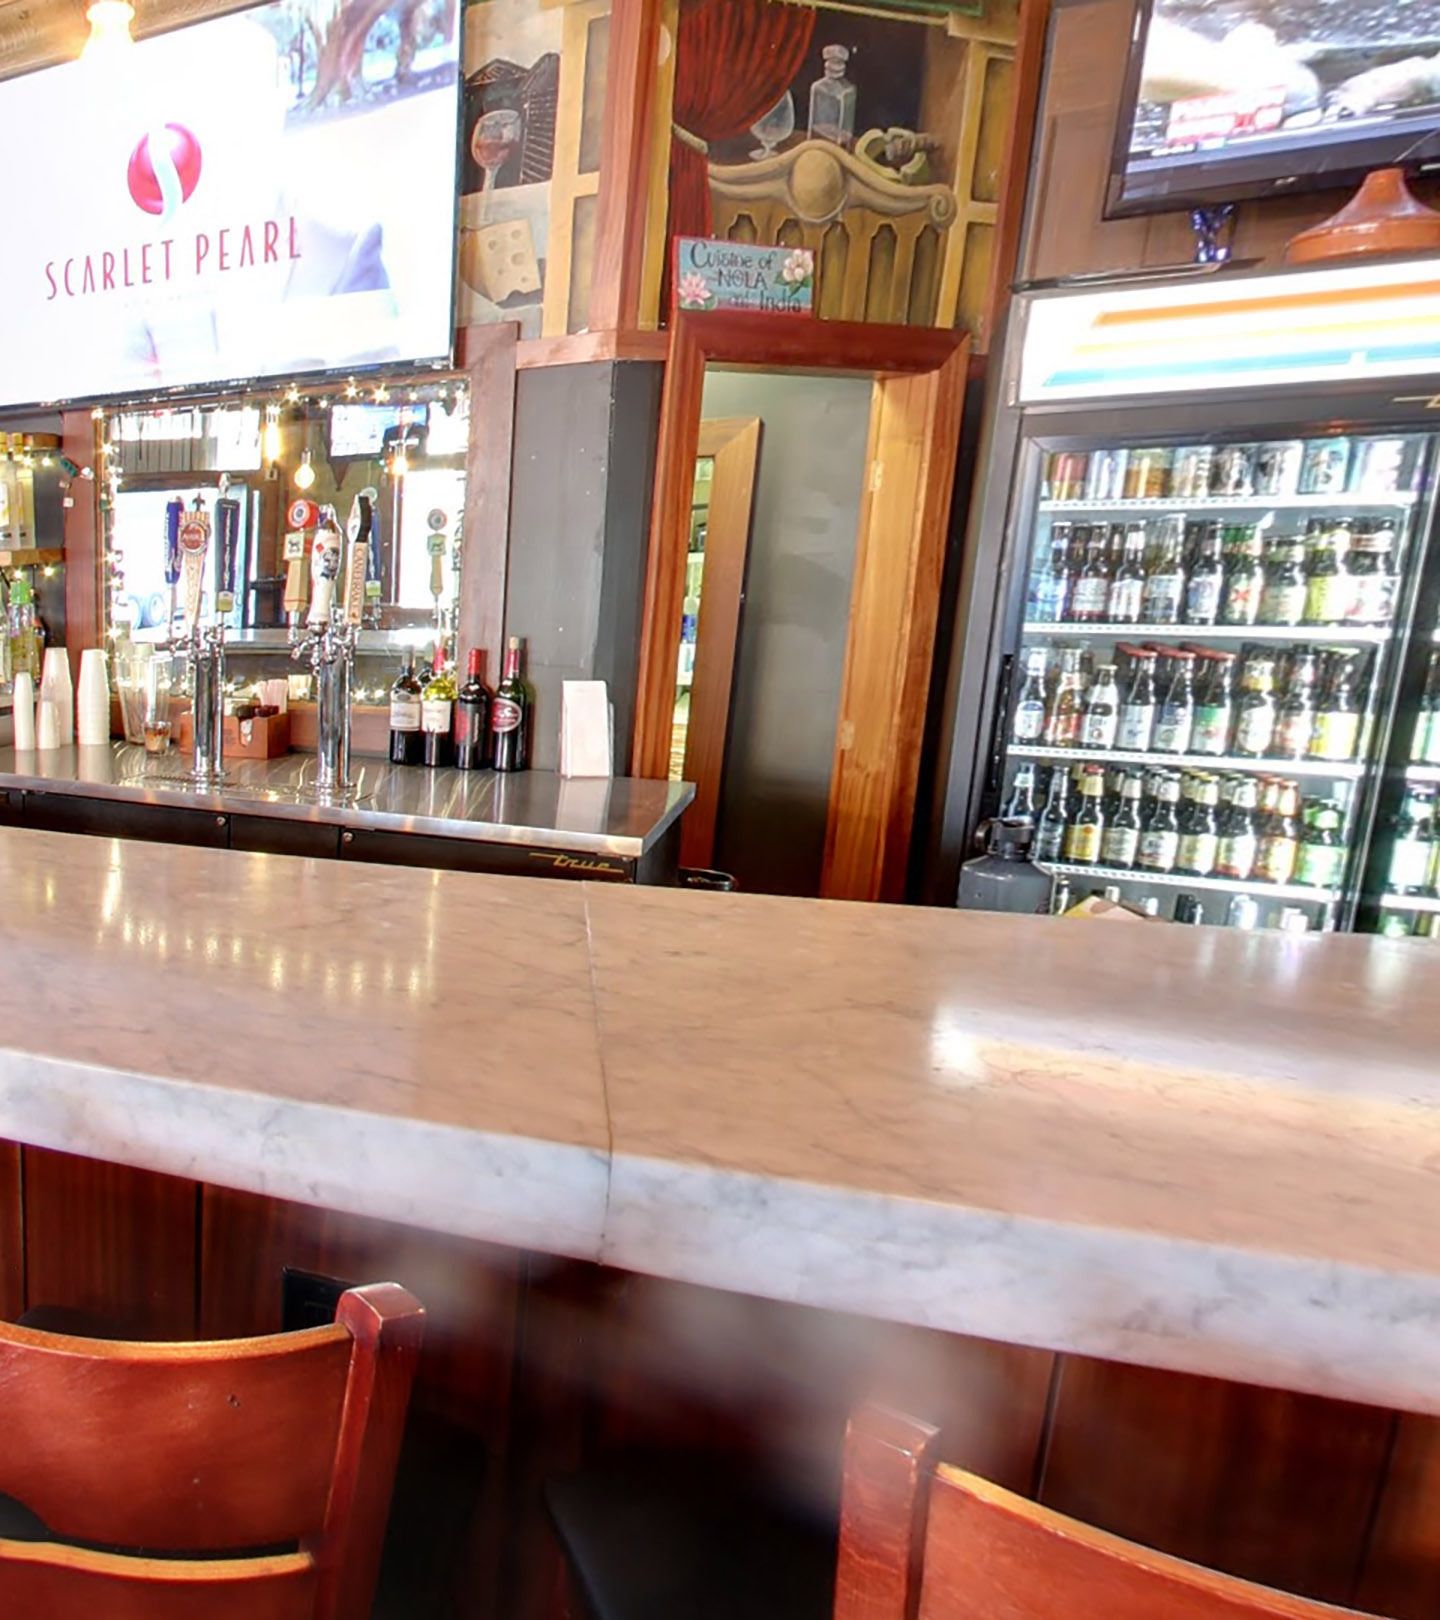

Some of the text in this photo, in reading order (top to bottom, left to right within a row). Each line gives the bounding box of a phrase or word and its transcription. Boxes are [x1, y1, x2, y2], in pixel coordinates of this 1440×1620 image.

[44, 216, 303, 301] SCARLET PEARL
[690, 241, 778, 270] Cuisine of
[717, 268, 768, 290] NOLA
[759, 289, 802, 313] India
